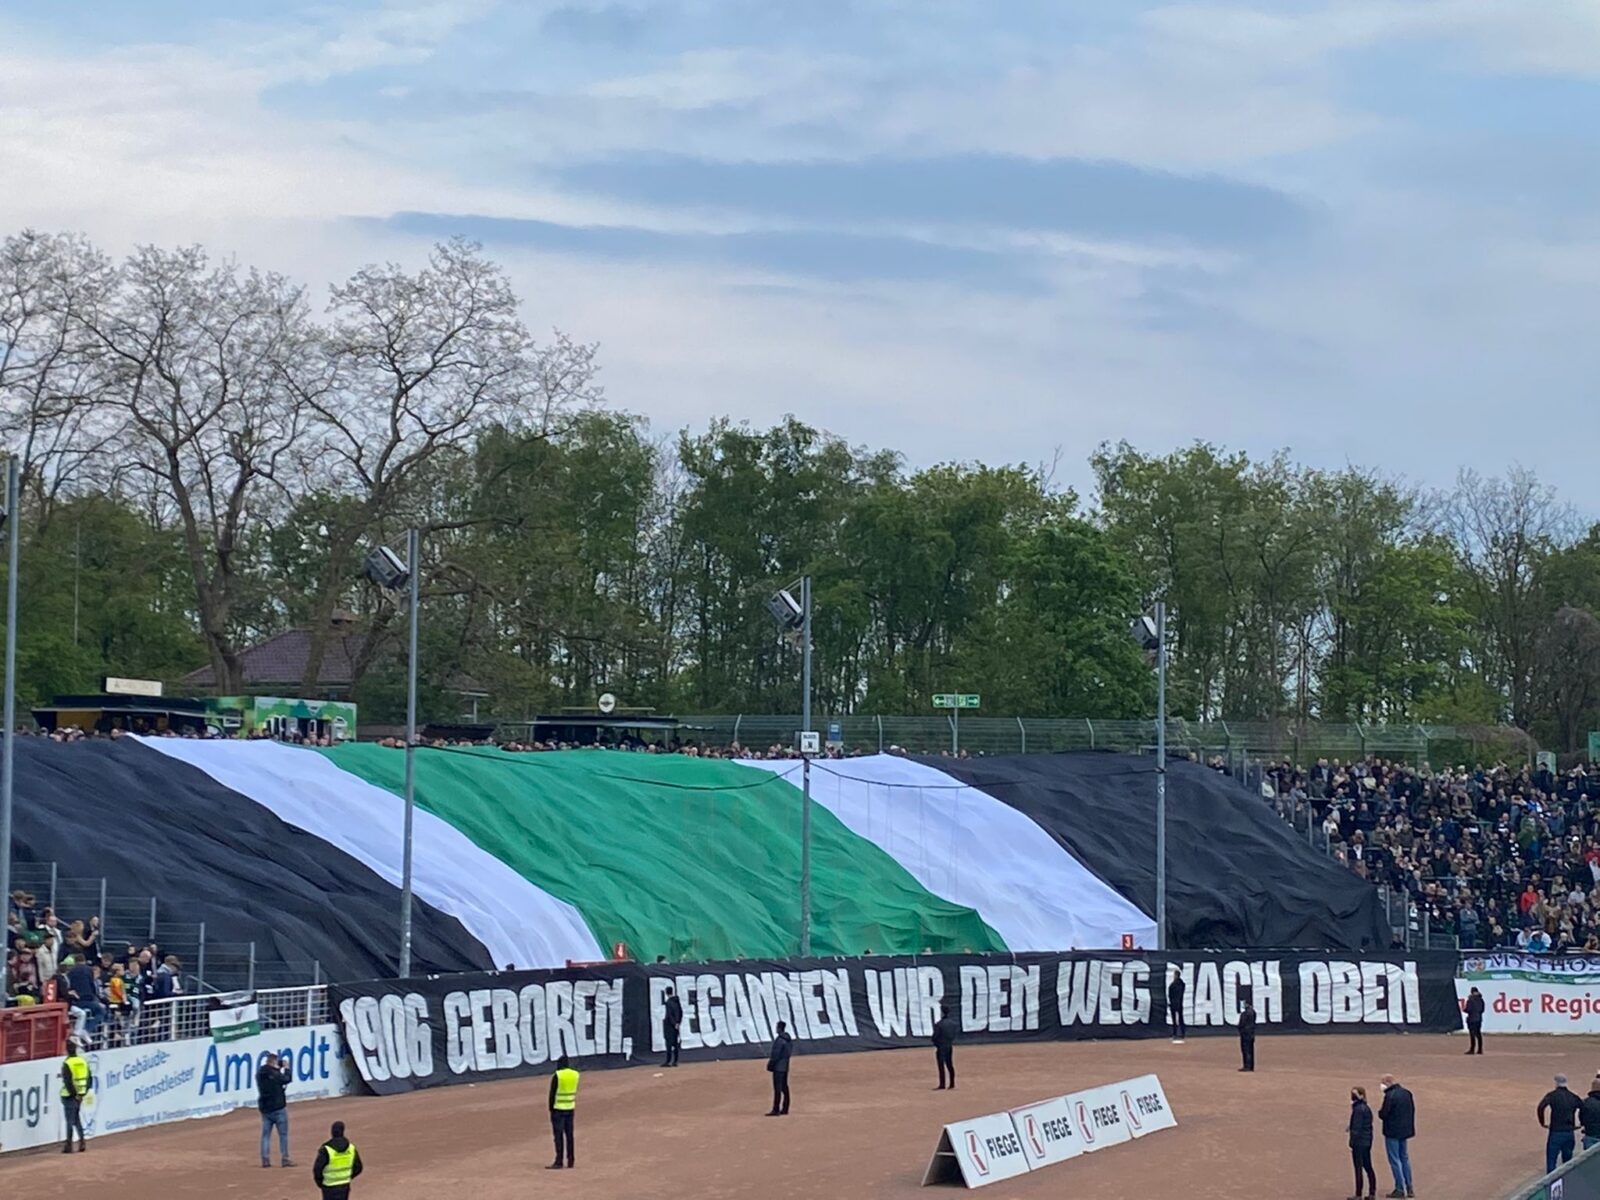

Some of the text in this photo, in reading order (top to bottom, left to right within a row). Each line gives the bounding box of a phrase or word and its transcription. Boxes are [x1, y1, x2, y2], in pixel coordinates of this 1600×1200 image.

[1492, 992, 1533, 1014] der
[339, 993, 434, 1081] 1906
[443, 978, 633, 1074] GEBOREN,
[865, 966, 945, 1038] WIR
[959, 964, 1041, 1033] DEN
[1056, 960, 1151, 1027] WEG
[1166, 960, 1283, 1026] NACH
[1299, 960, 1422, 1024] OBEN
[105, 1070, 121, 1089] Ihr
[134, 1067, 195, 1104] Dienstleister
[1092, 1104, 1120, 1129] FIEGE
[1136, 1093, 1164, 1116] FIEGE
[1042, 1117, 1073, 1142] FIEGE
[986, 1133, 1020, 1159] FIEGE
